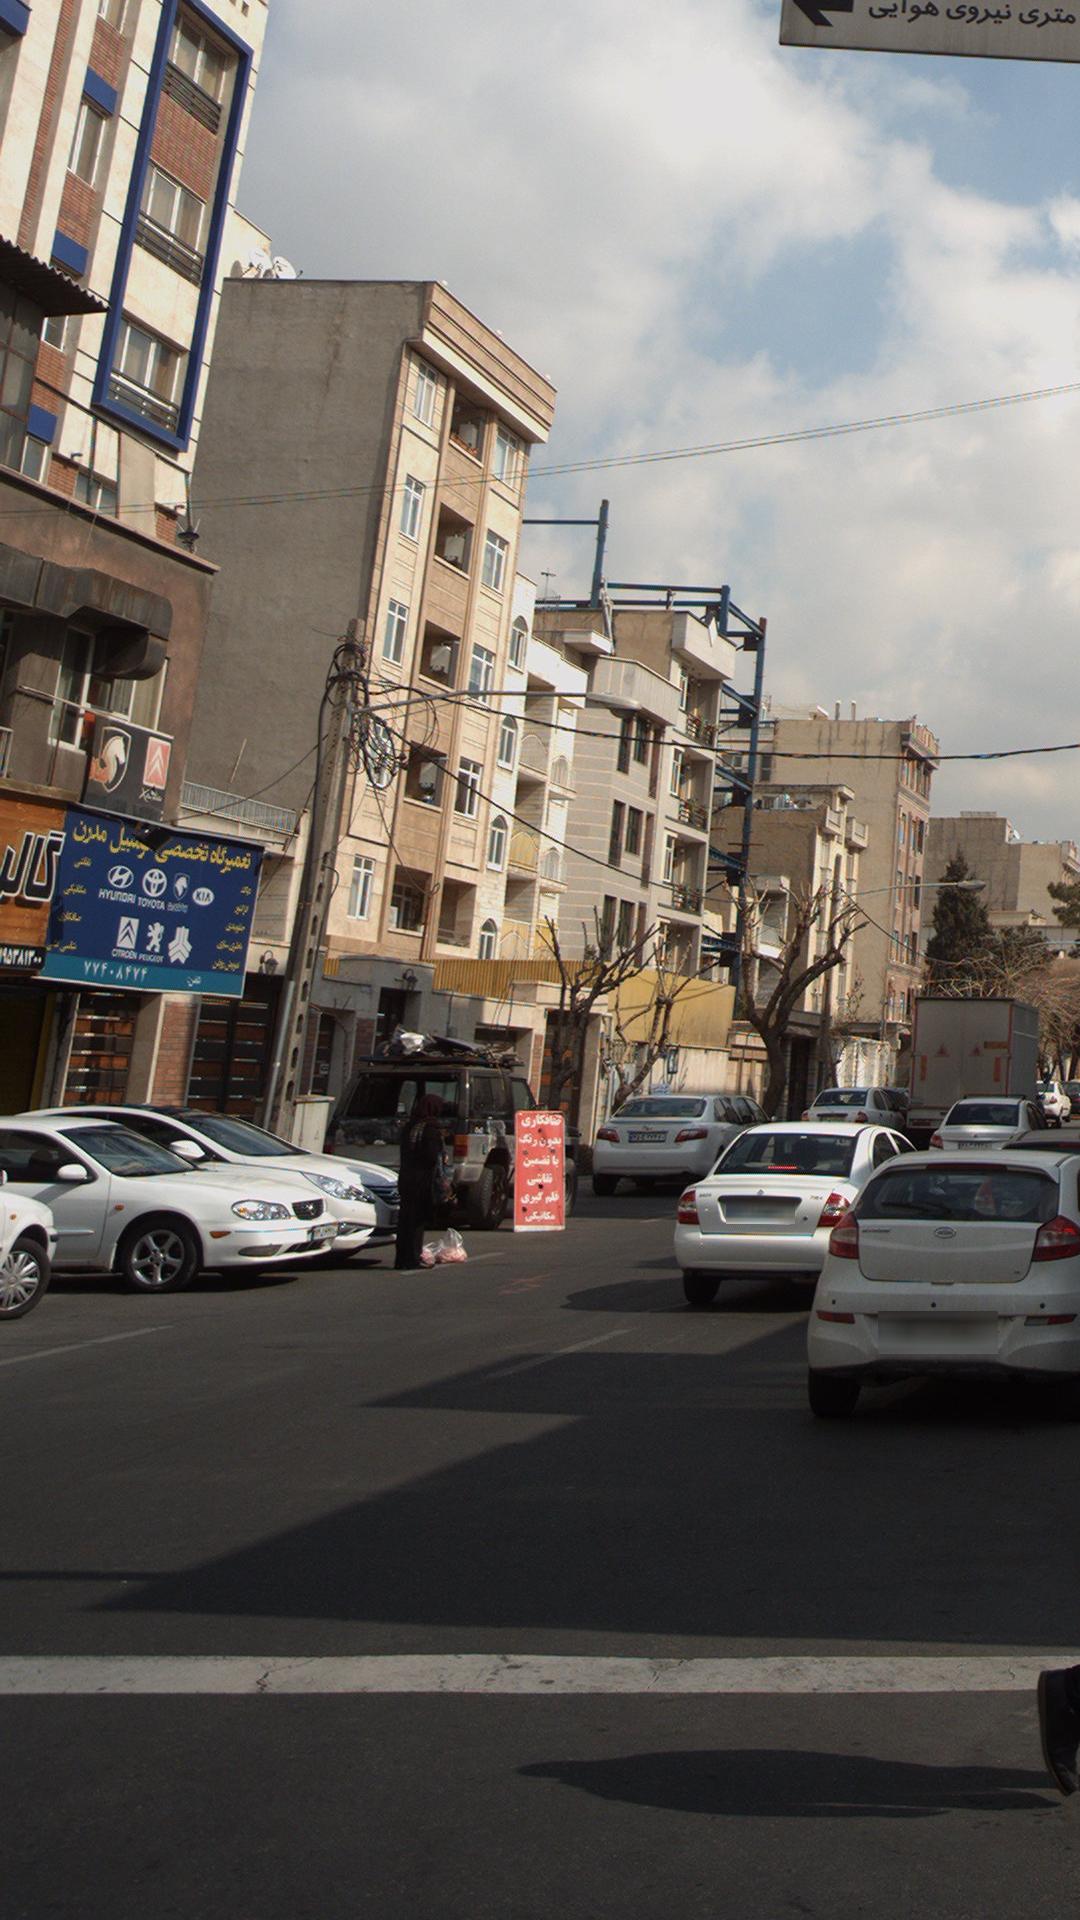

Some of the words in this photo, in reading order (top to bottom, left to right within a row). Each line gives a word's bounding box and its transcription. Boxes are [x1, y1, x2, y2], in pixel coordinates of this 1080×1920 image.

[868, 0, 940, 23] هوایی
[945, 3, 1012, 24] نیروی
[1018, 6, 1077, 28] متری
[155, 842, 209, 864] تخصصی
[210, 845, 252, 873] تعمیرگاه
[98, 888, 137, 904] HYUNDAI
[138, 897, 166, 910] TOYOTA
[519, 1133, 538, 1147] رنگ
[539, 1137, 561, 1150] بدون
[523, 1155, 551, 1168] تضمین
[552, 1155, 559, 1168] با
[527, 1173, 553, 1186] نقاشی
[525, 1211, 556, 1222] مکانیکی
